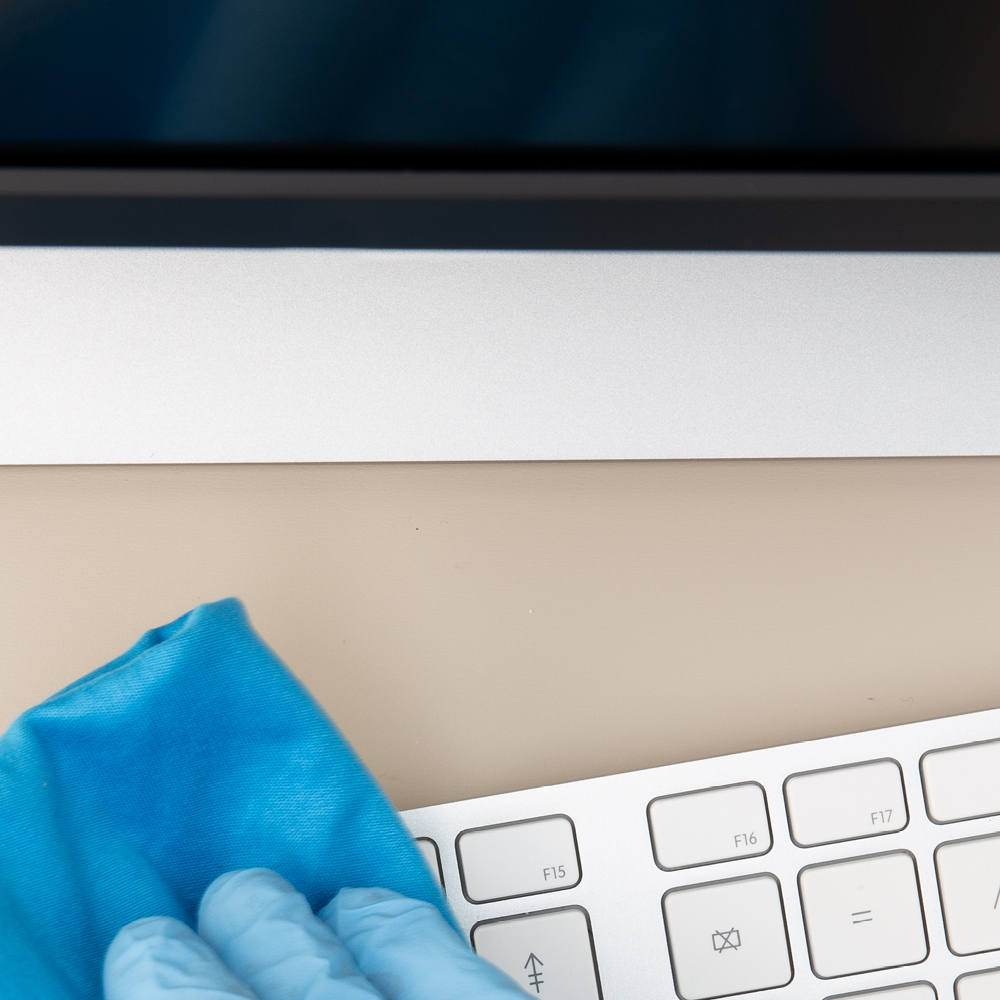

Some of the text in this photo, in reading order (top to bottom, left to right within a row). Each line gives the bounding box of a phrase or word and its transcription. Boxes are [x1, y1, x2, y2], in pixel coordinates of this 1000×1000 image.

[870, 809, 894, 826] F17
[733, 832, 758, 848] F16
[543, 865, 567, 882] F15
